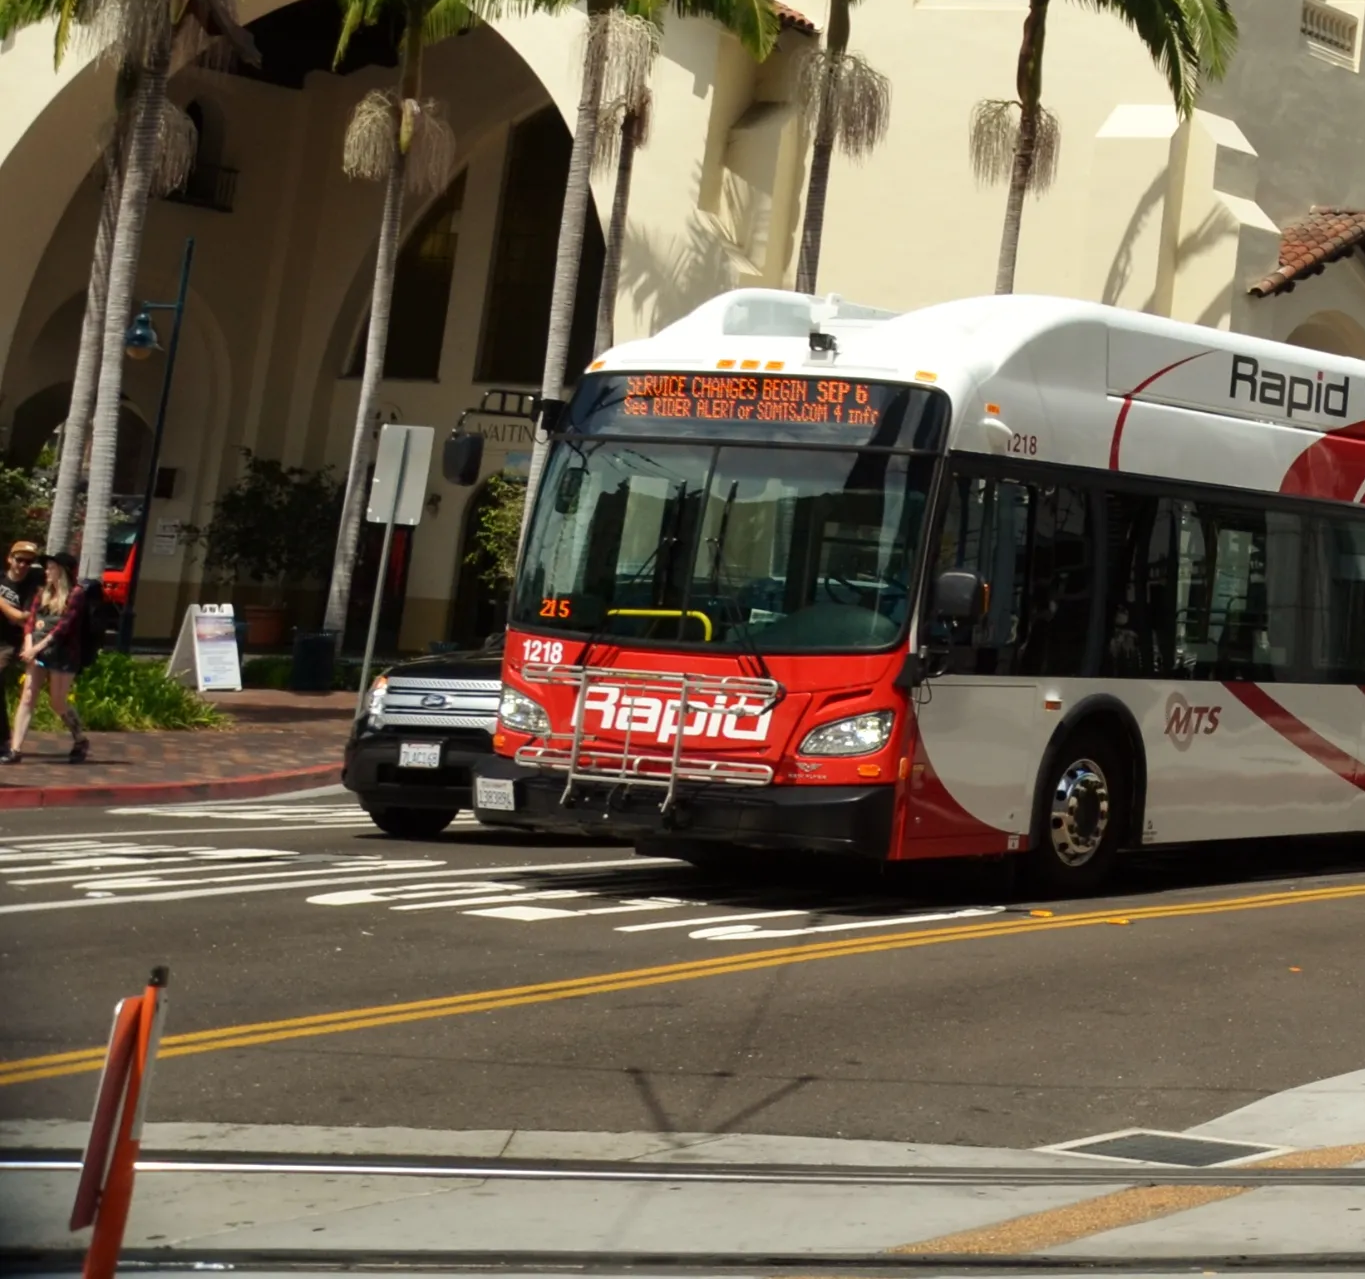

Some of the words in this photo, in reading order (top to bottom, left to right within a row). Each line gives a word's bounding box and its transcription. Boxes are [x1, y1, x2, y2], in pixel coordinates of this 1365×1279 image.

[626, 375, 687, 398] SERVICE
[691, 377, 757, 400] CHANGES
[762, 379, 807, 402] BEGIN
[816, 380, 850, 404] SEP
[855, 383, 868, 405] 6
[1229, 353, 1350, 419] Rapid
[624, 398, 648, 416] See
[652, 398, 691, 418] RIDER
[696, 400, 736, 420] ALERT
[737, 404, 753, 420] or
[478, 422, 535, 443] WAITIN
[1006, 433, 1038, 456] 1218
[539, 598, 571, 618] 215
[523, 639, 563, 664] 1218
[570, 686, 775, 743] Rapid
[1164, 706, 1222, 735] MTS
